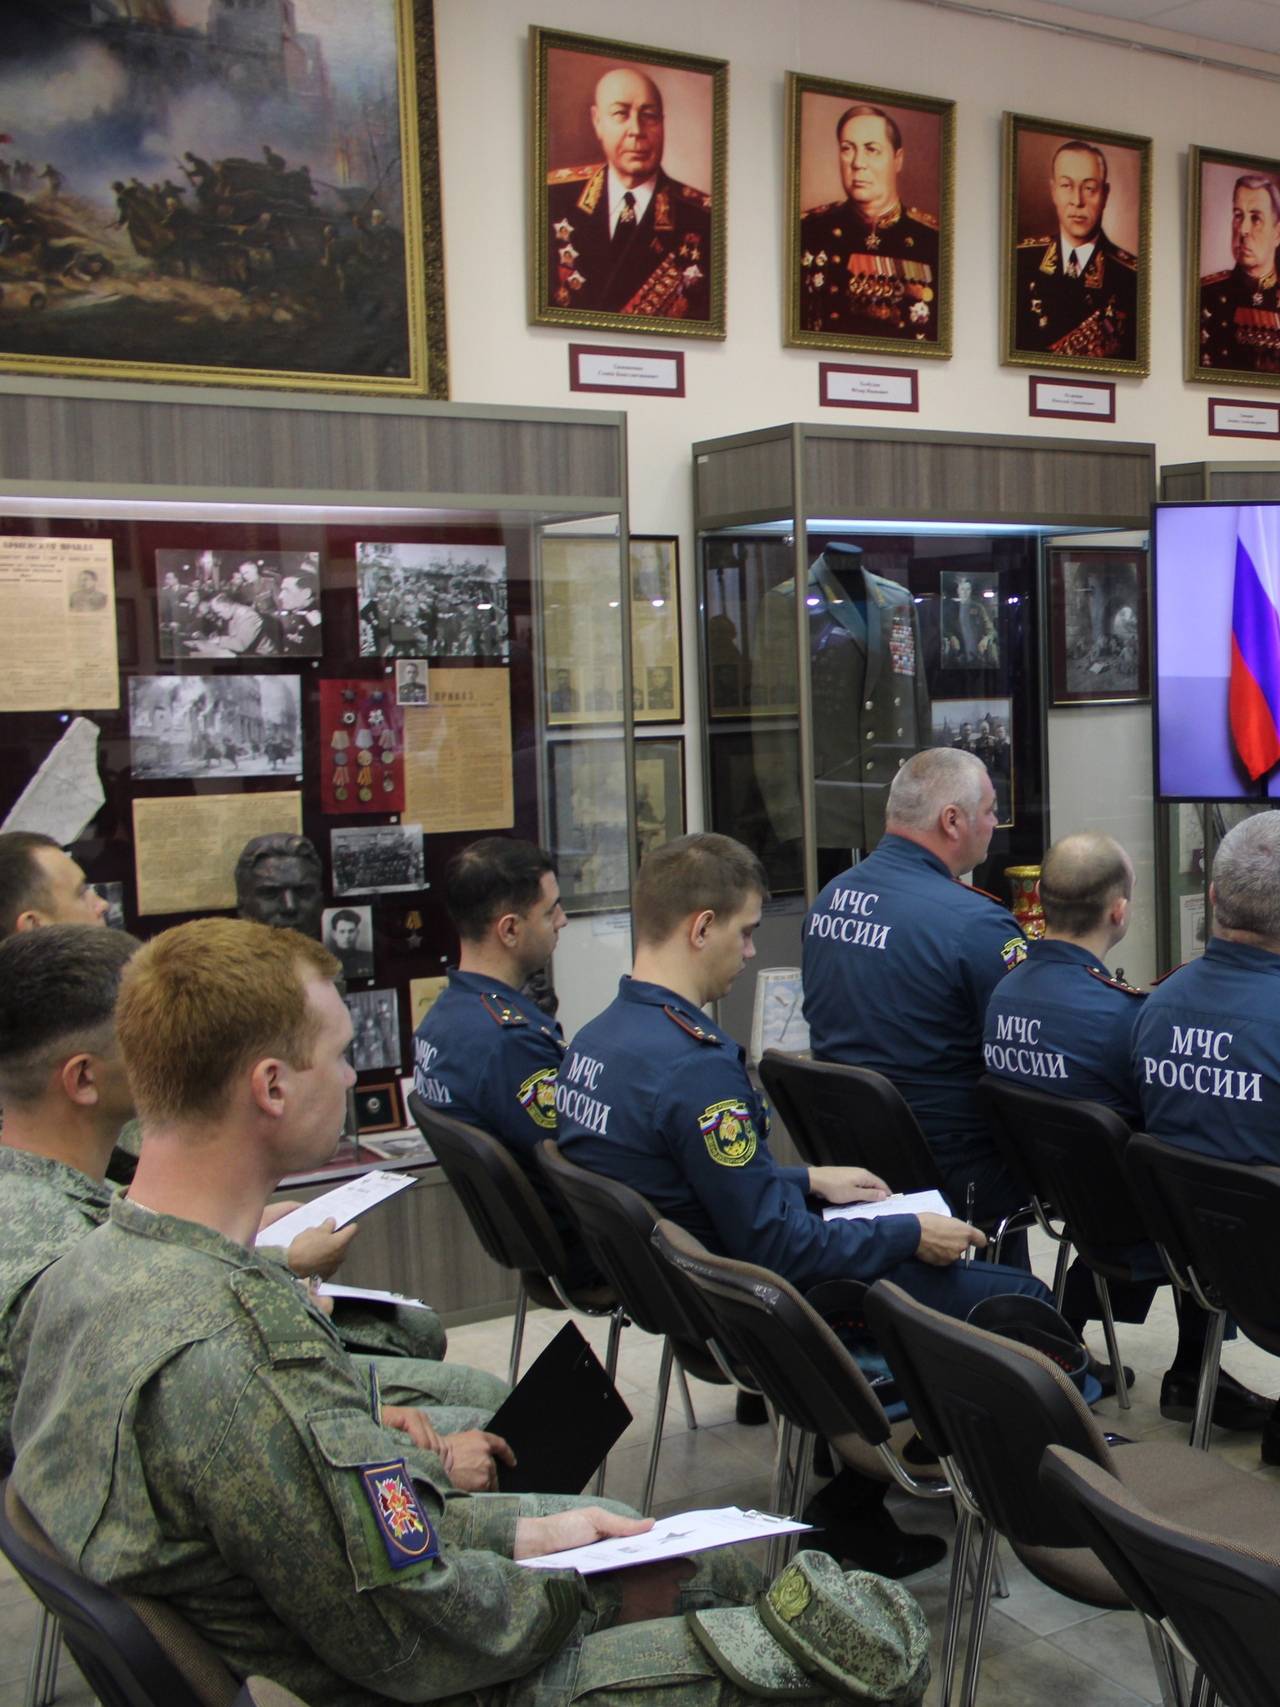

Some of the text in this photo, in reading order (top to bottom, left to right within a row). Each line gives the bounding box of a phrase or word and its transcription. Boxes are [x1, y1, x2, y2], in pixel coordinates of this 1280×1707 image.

[829, 888, 880, 916] МЧС
[809, 913, 892, 950] РОССИИ
[996, 1014, 1042, 1046] МЧС
[1170, 1025, 1234, 1062] МЧС
[414, 1036, 438, 1073] МЧС
[566, 1052, 604, 1091] МЧС
[984, 1043, 1069, 1079] РОССИИ
[413, 1065, 453, 1104] ОССИИ
[1143, 1057, 1264, 1103] РОССИИ
[555, 1082, 612, 1136] ОССИИ
